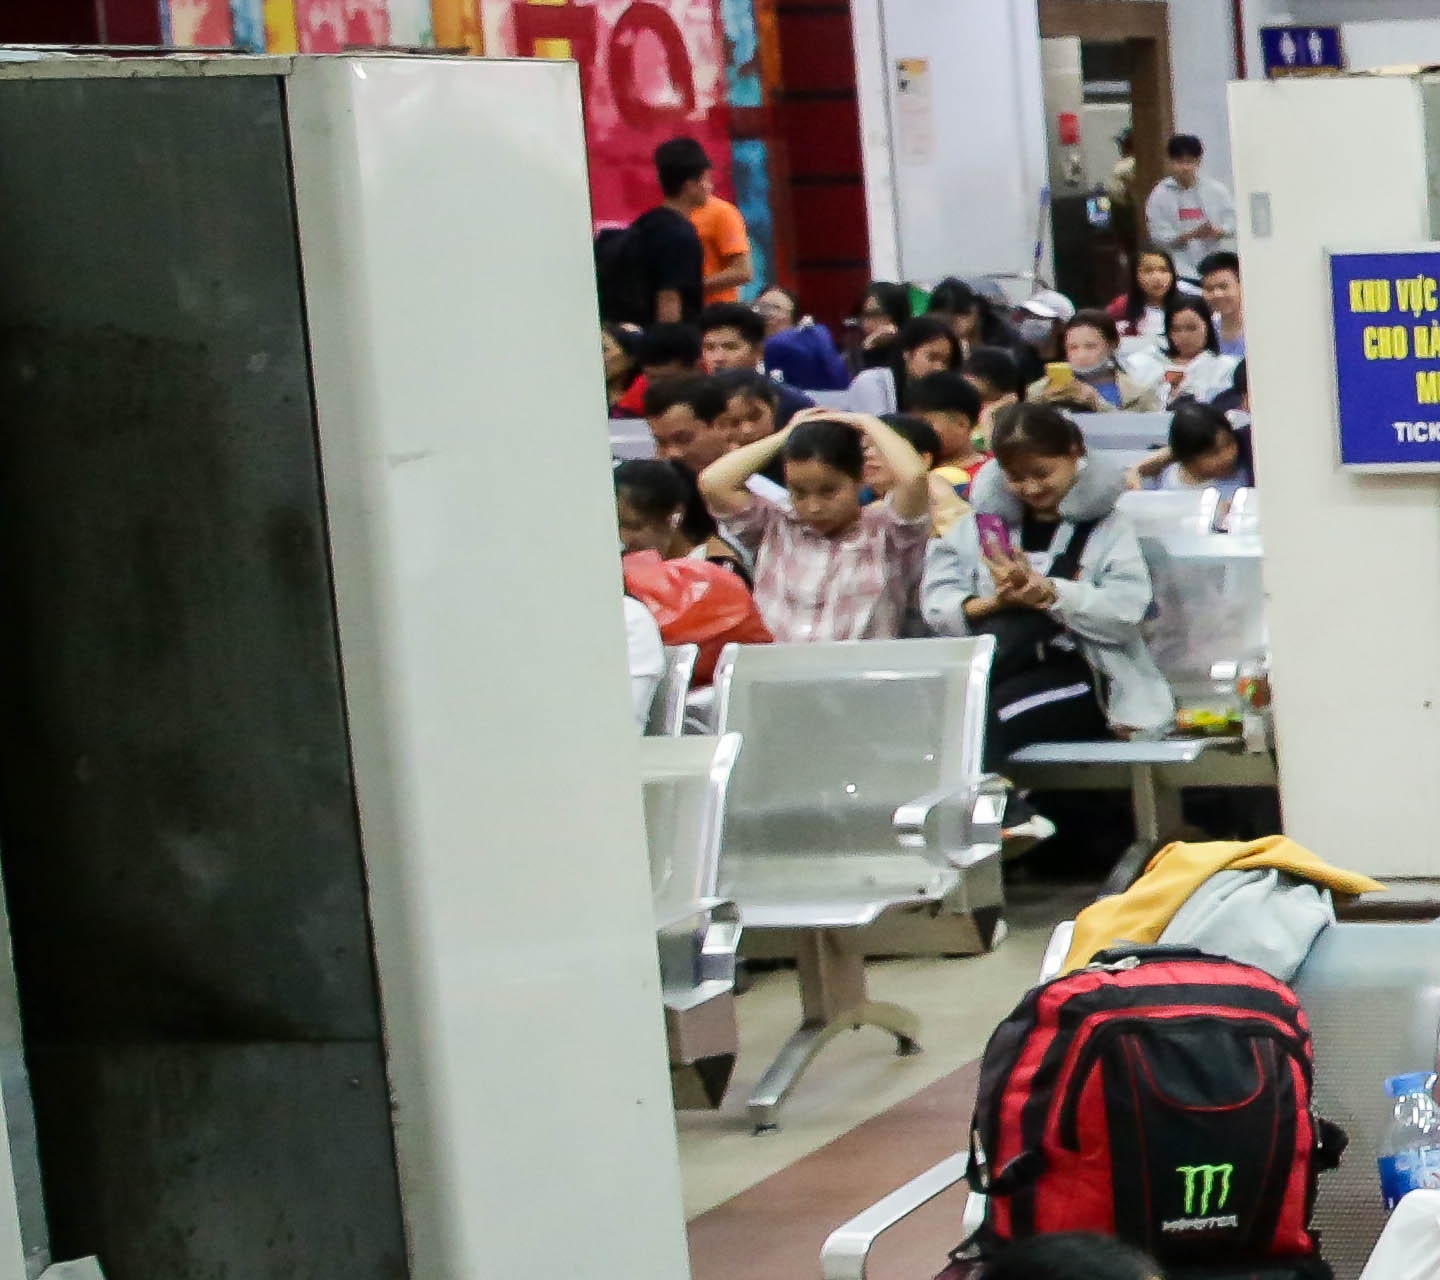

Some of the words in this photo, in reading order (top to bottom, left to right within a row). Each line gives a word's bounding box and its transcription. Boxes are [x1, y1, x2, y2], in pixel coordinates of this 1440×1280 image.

[1349, 279, 1391, 312] KHU
[1396, 274, 1438, 318] VỰC
[1363, 326, 1408, 360] CHO
